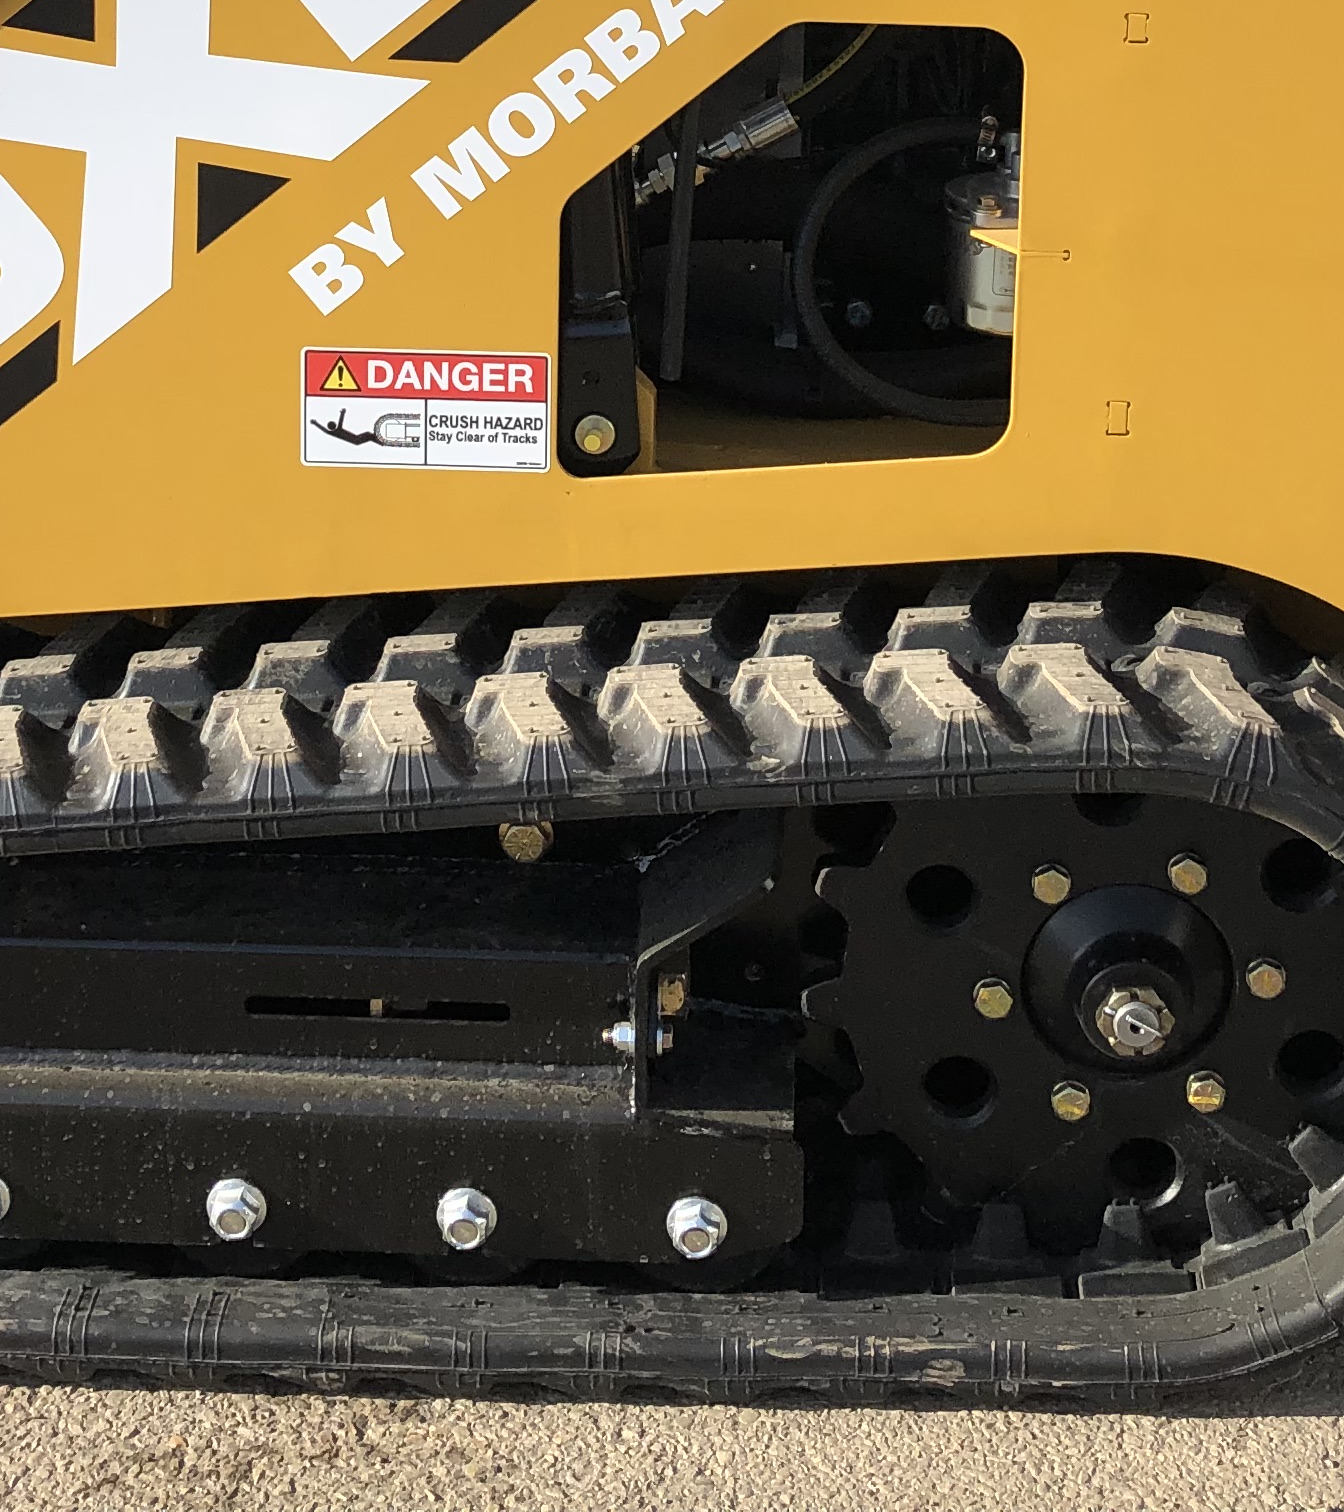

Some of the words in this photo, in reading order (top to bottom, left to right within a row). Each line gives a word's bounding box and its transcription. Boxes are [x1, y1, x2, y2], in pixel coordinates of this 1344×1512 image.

[287, 196, 407, 316] BY
[367, 360, 533, 393] DANGER
[429, 415, 479, 429] CRUSH
[484, 415, 543, 430] HAZARD
[429, 430, 453, 444] Stay
[456, 431, 484, 442] Clear
[488, 431, 499, 443] of
[502, 432, 538, 444] Tracks
